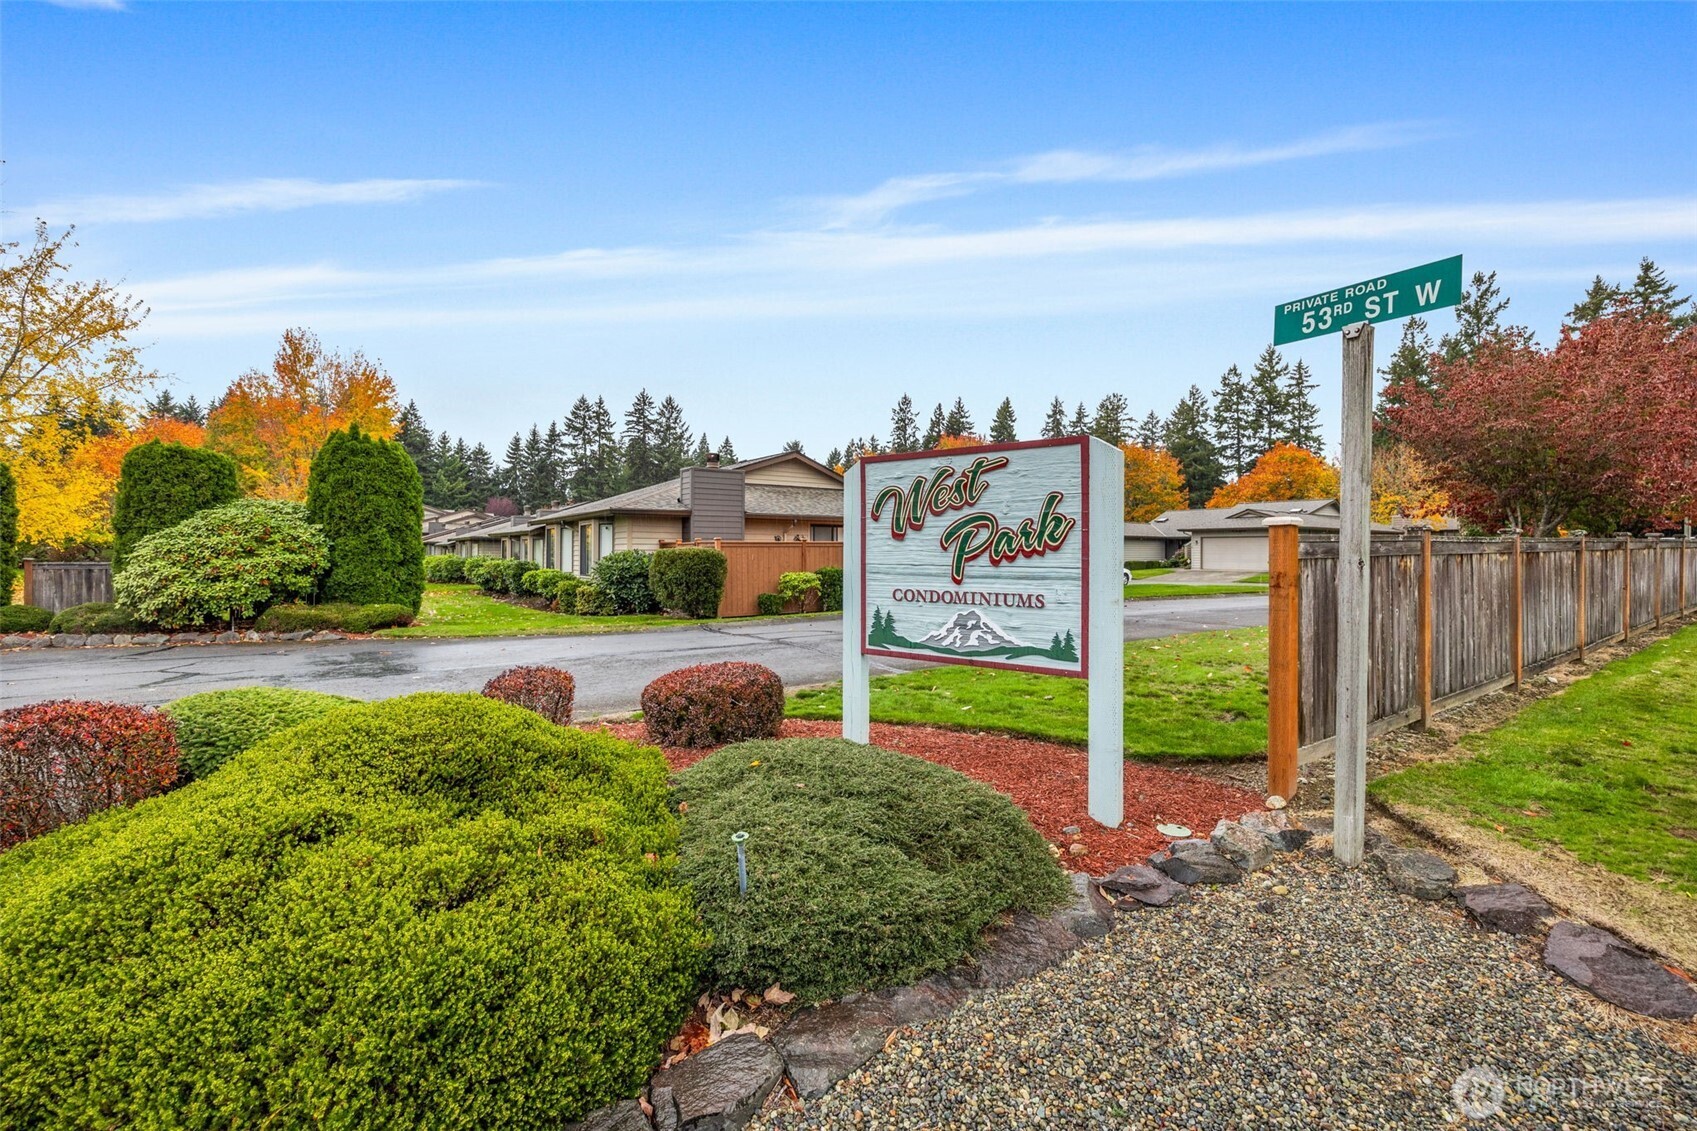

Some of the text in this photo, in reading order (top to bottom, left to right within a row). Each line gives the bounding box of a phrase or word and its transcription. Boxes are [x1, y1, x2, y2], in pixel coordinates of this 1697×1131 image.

[1284, 279, 1387, 315] PRIVATE ROAD
[1301, 279, 1442, 334] 53RD ST W
[871, 456, 1009, 540] West
[940, 491, 1076, 585] Park
[892, 588, 1045, 609] CONDOMINIUMS
